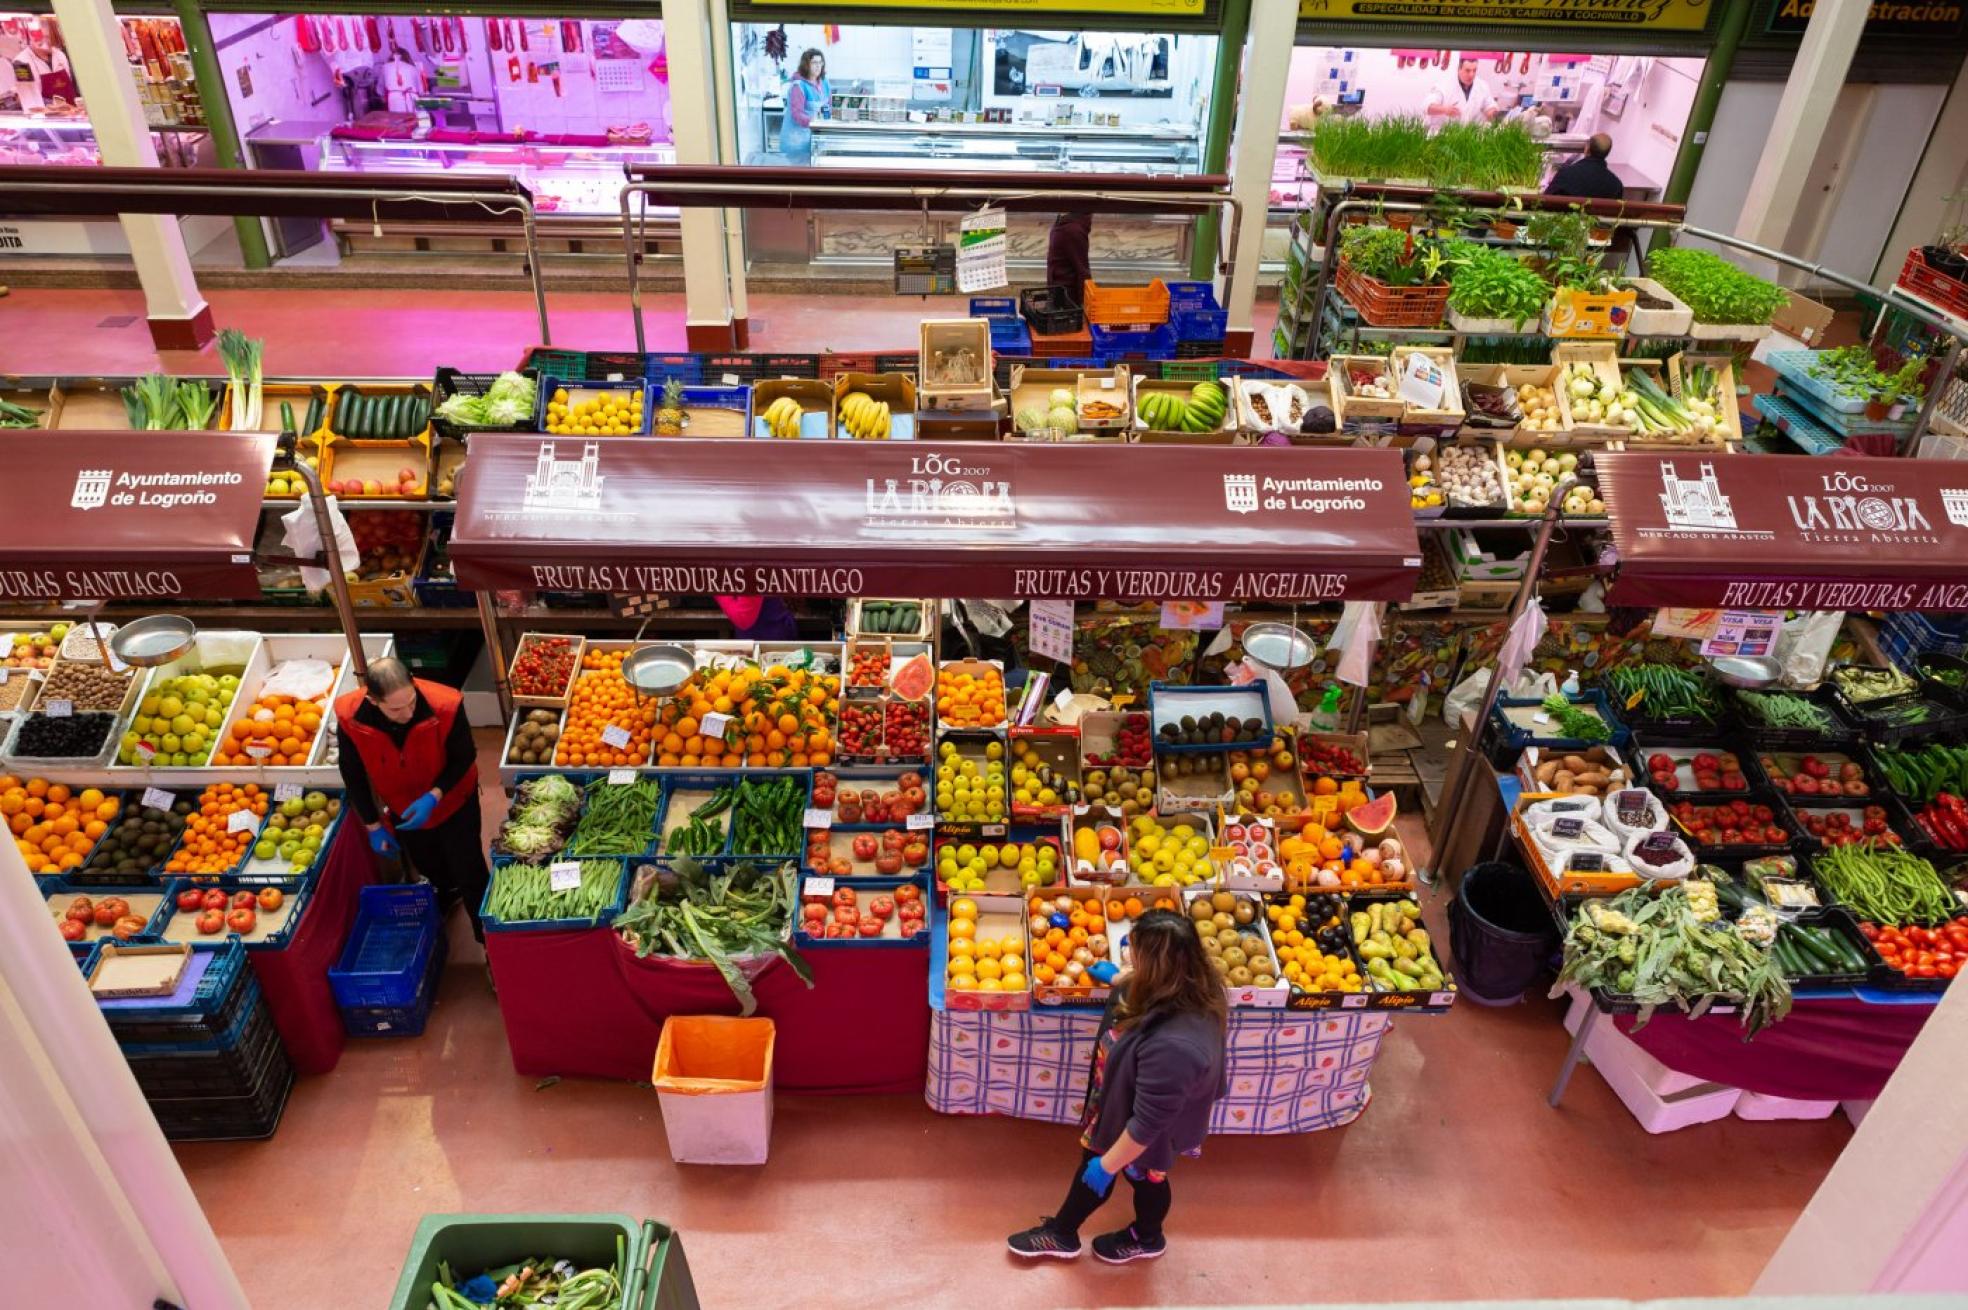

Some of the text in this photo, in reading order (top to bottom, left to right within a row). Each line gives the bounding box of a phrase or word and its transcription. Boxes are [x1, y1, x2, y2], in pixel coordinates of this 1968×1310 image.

[1358, 4, 1639, 20] ESPECIALIDAD EN CORDERO, CABRITO Y COCHINILLO
[1780, 0, 1961, 21] Adstración
[115, 470, 243, 490] Ayuntamiento
[962, 467, 990, 476] 2007
[1262, 477, 1383, 494] Ayuntamiento
[1869, 484, 1895, 493] 2007
[110, 490, 217, 508] de Logroño
[1263, 495, 1366, 513] de Logroño
[1787, 495, 1831, 530] LA
[1638, 531, 1698, 539] MERCADO
[1723, 532, 1776, 541] ABASTOS
[1800, 532, 1940, 545] Tierra Abierta
[66, 571, 182, 597] SANTIAGO
[531, 566, 863, 594] FRUTAS Y VERDURAS SANTIAGO
[1013, 569, 1348, 598] FRUTAS Y VERDURAS ANGELINES
[1719, 582, 1799, 606] FRUTAS
[1797, 582, 1816, 606] Y
[1817, 583, 1918, 607] VERDURAS
